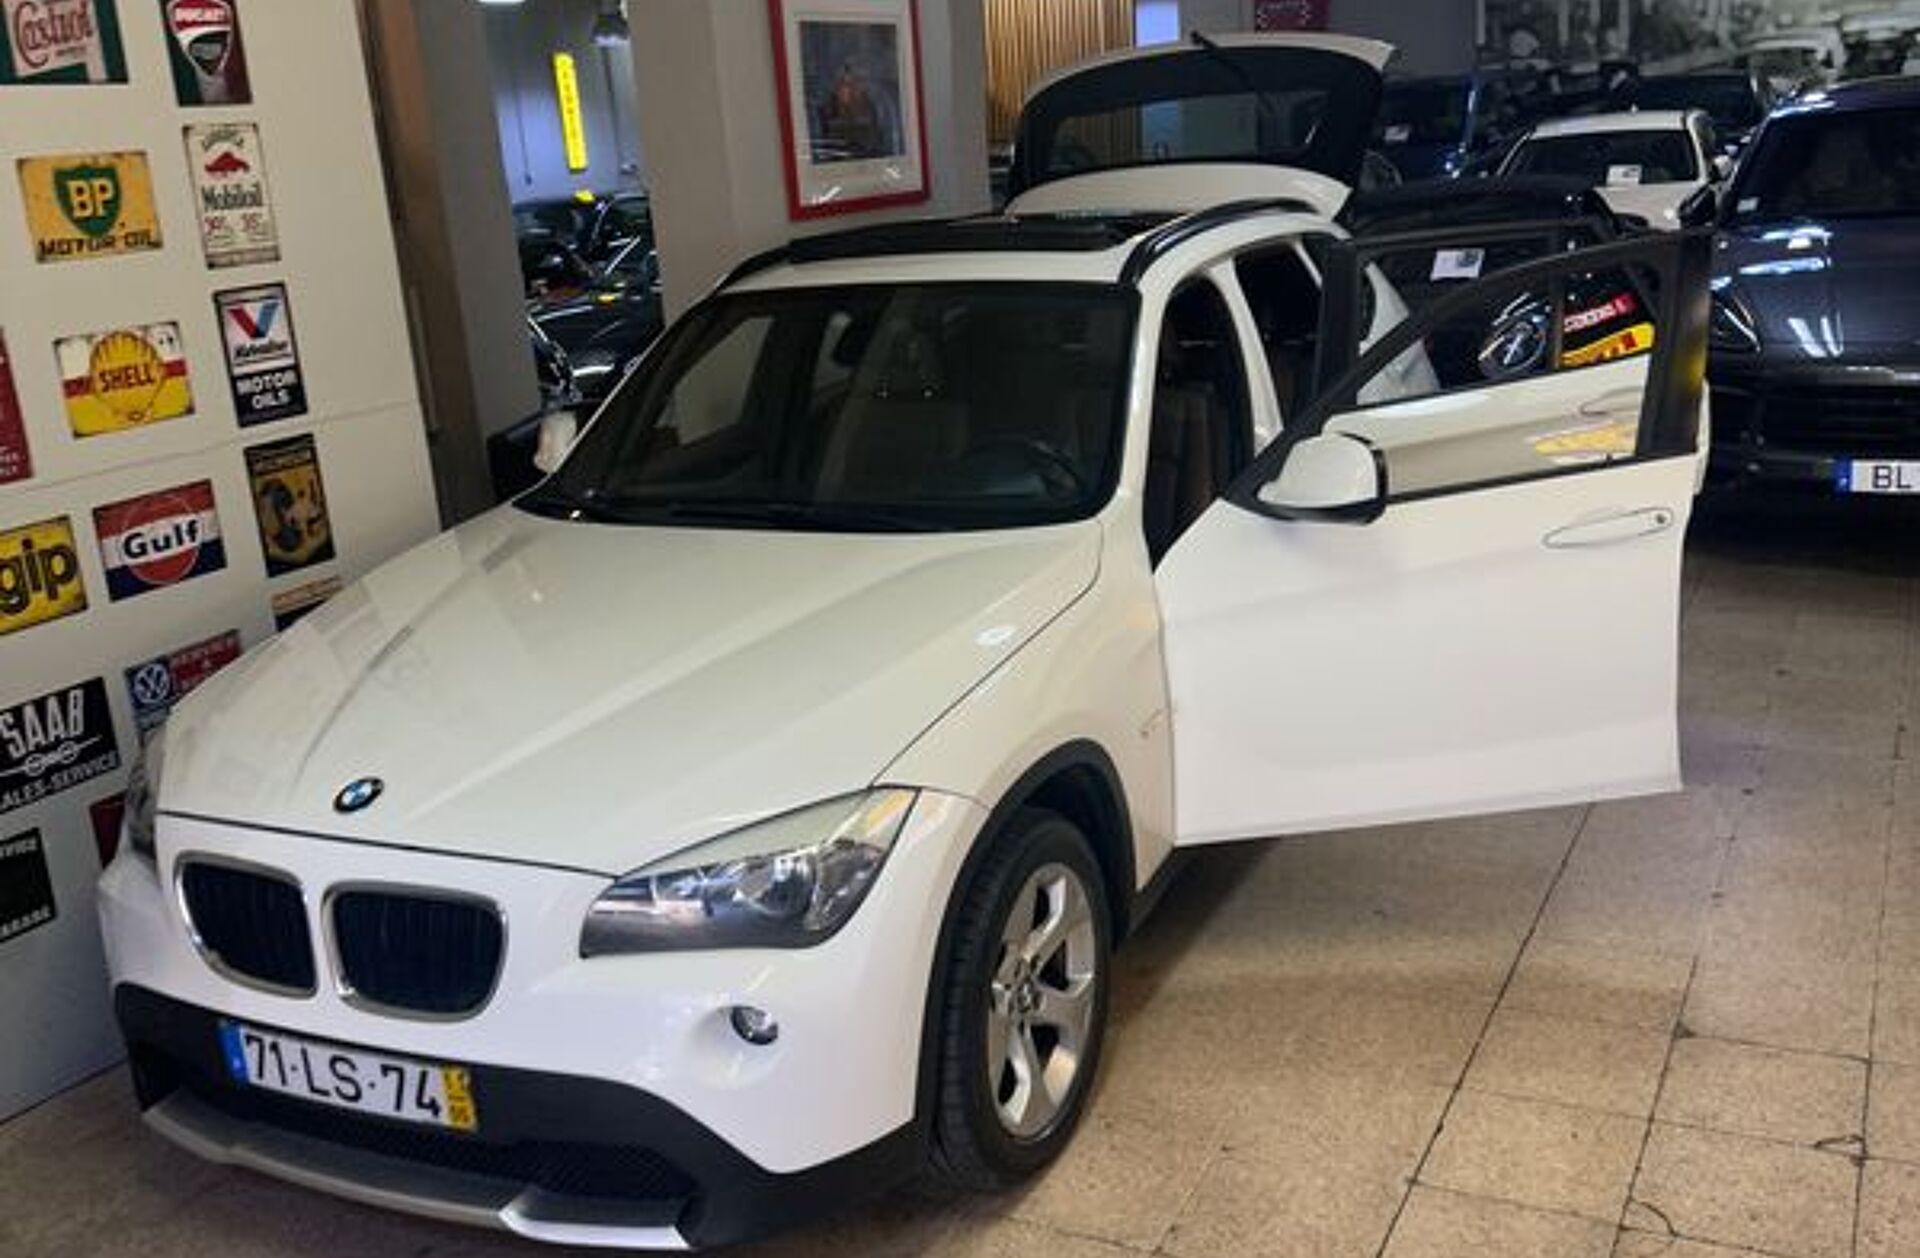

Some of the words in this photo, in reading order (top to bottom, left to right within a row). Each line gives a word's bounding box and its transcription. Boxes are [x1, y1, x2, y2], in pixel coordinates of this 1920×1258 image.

[66, 177, 114, 218] BP
[38, 234, 116, 256] MOTOR
[99, 363, 155, 393] SHELL
[236, 369, 298, 395] MOTOR
[252, 388, 290, 409] OILS
[1872, 465, 1912, 489] BL
[123, 519, 199, 559] Gulf
[0, 689, 84, 759] SAAB
